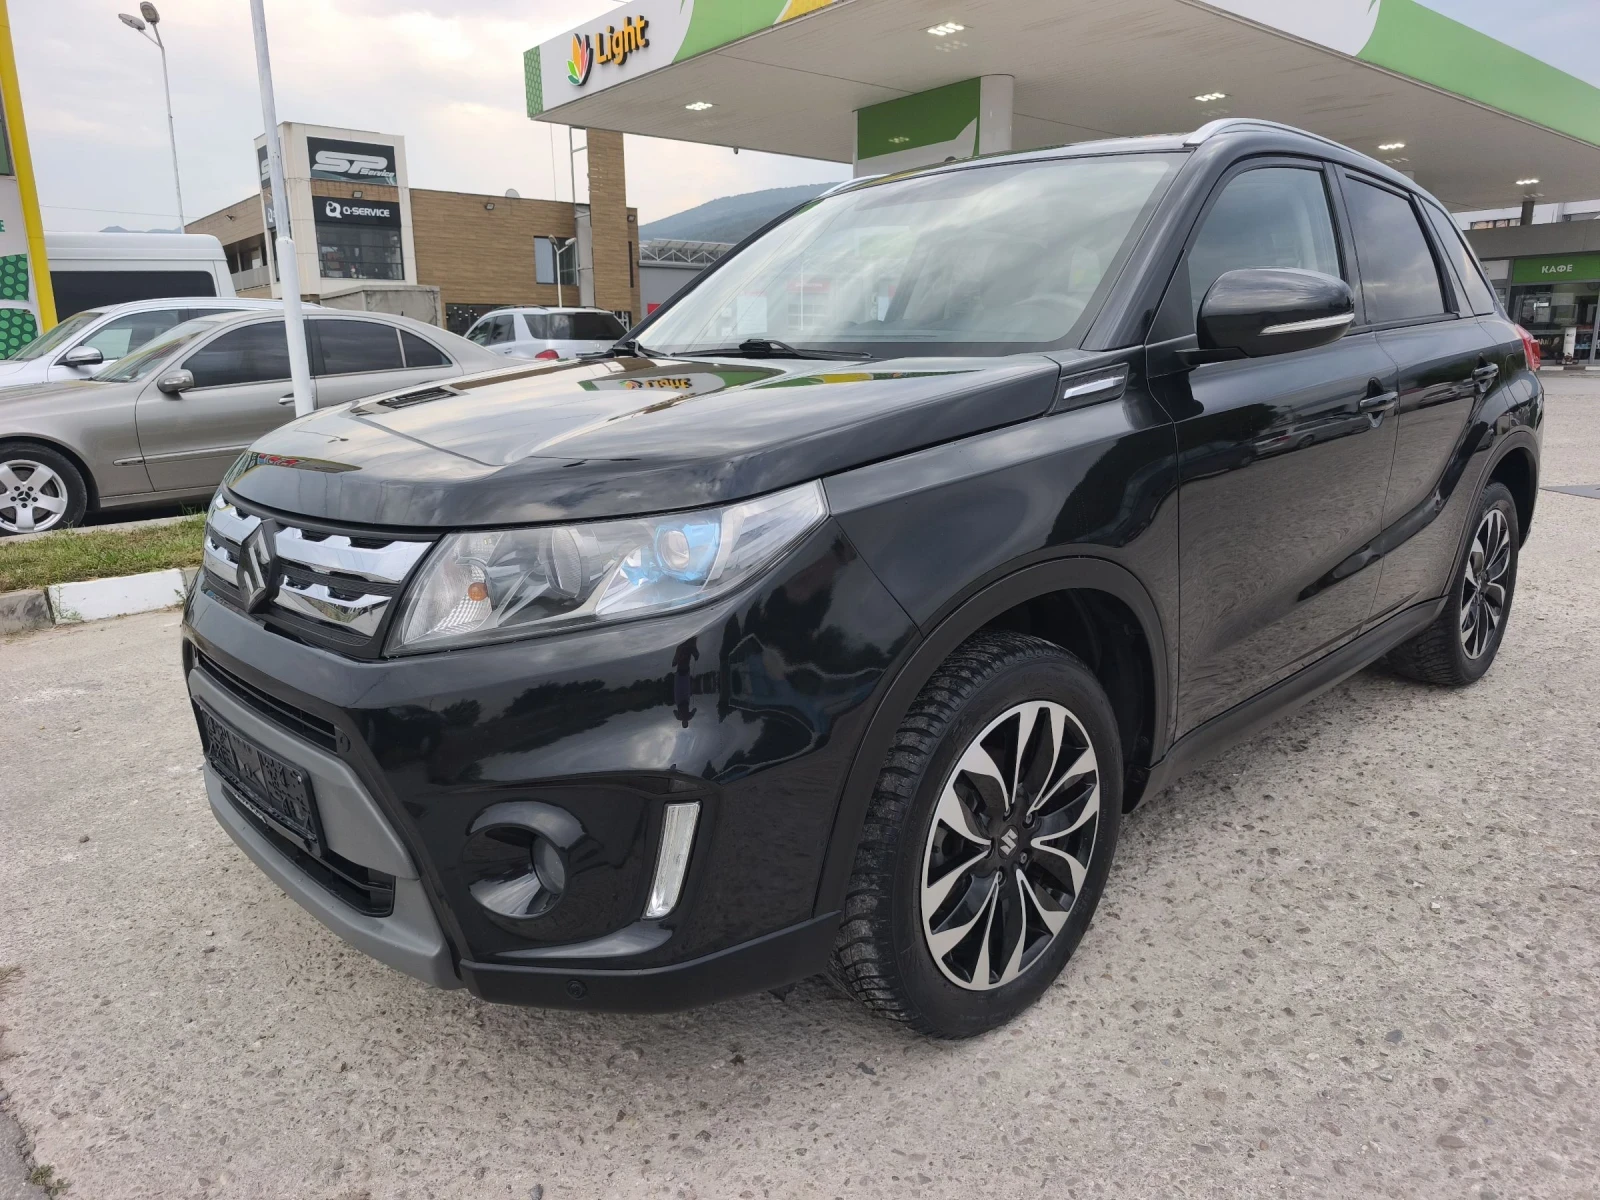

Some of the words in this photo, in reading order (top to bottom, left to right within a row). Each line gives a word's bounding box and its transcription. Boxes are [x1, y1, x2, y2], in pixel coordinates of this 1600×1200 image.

[595, 14, 650, 66] Light
[312, 150, 388, 173] SP
[359, 168, 395, 178] Service
[342, 206, 390, 218] Q-SERVICE
[1541, 264, 1574, 274] КАФЕ
